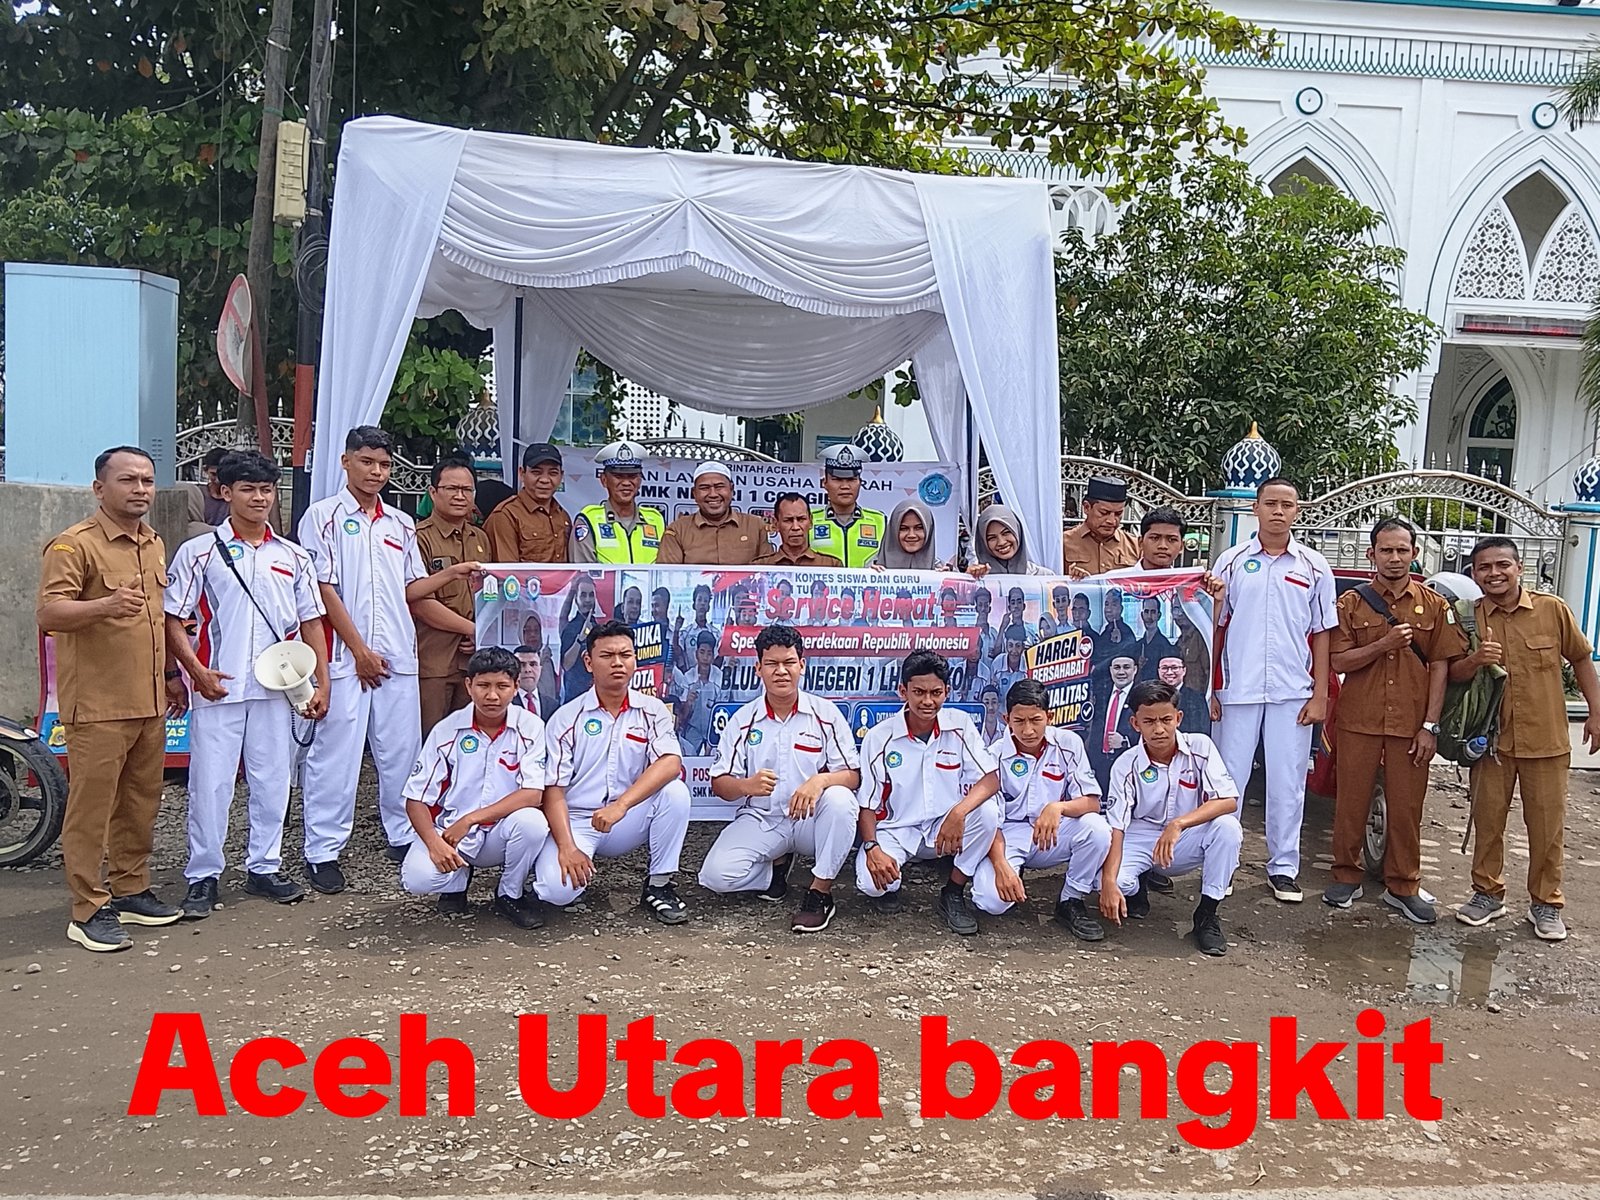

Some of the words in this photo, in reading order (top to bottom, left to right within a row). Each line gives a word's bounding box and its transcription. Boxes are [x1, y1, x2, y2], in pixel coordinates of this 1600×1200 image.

[766, 465, 795, 475] ACEH
[753, 476, 815, 488] USAHA
[795, 573, 834, 583] KONTES
[838, 575, 868, 583] SISWA
[870, 576, 891, 584] DAN
[893, 576, 921, 584] GURU
[765, 587, 854, 620] Service
[862, 587, 937, 621] Hemat
[862, 633, 912, 653] Republik
[914, 633, 970, 650] Indonesia
[1035, 636, 1078, 666] HARGA
[803, 667, 861, 692] NEGERI
[867, 667, 875, 691] 1
[1032, 660, 1086, 682] BERSAHABAT
[692, 786, 707, 798] SMK
